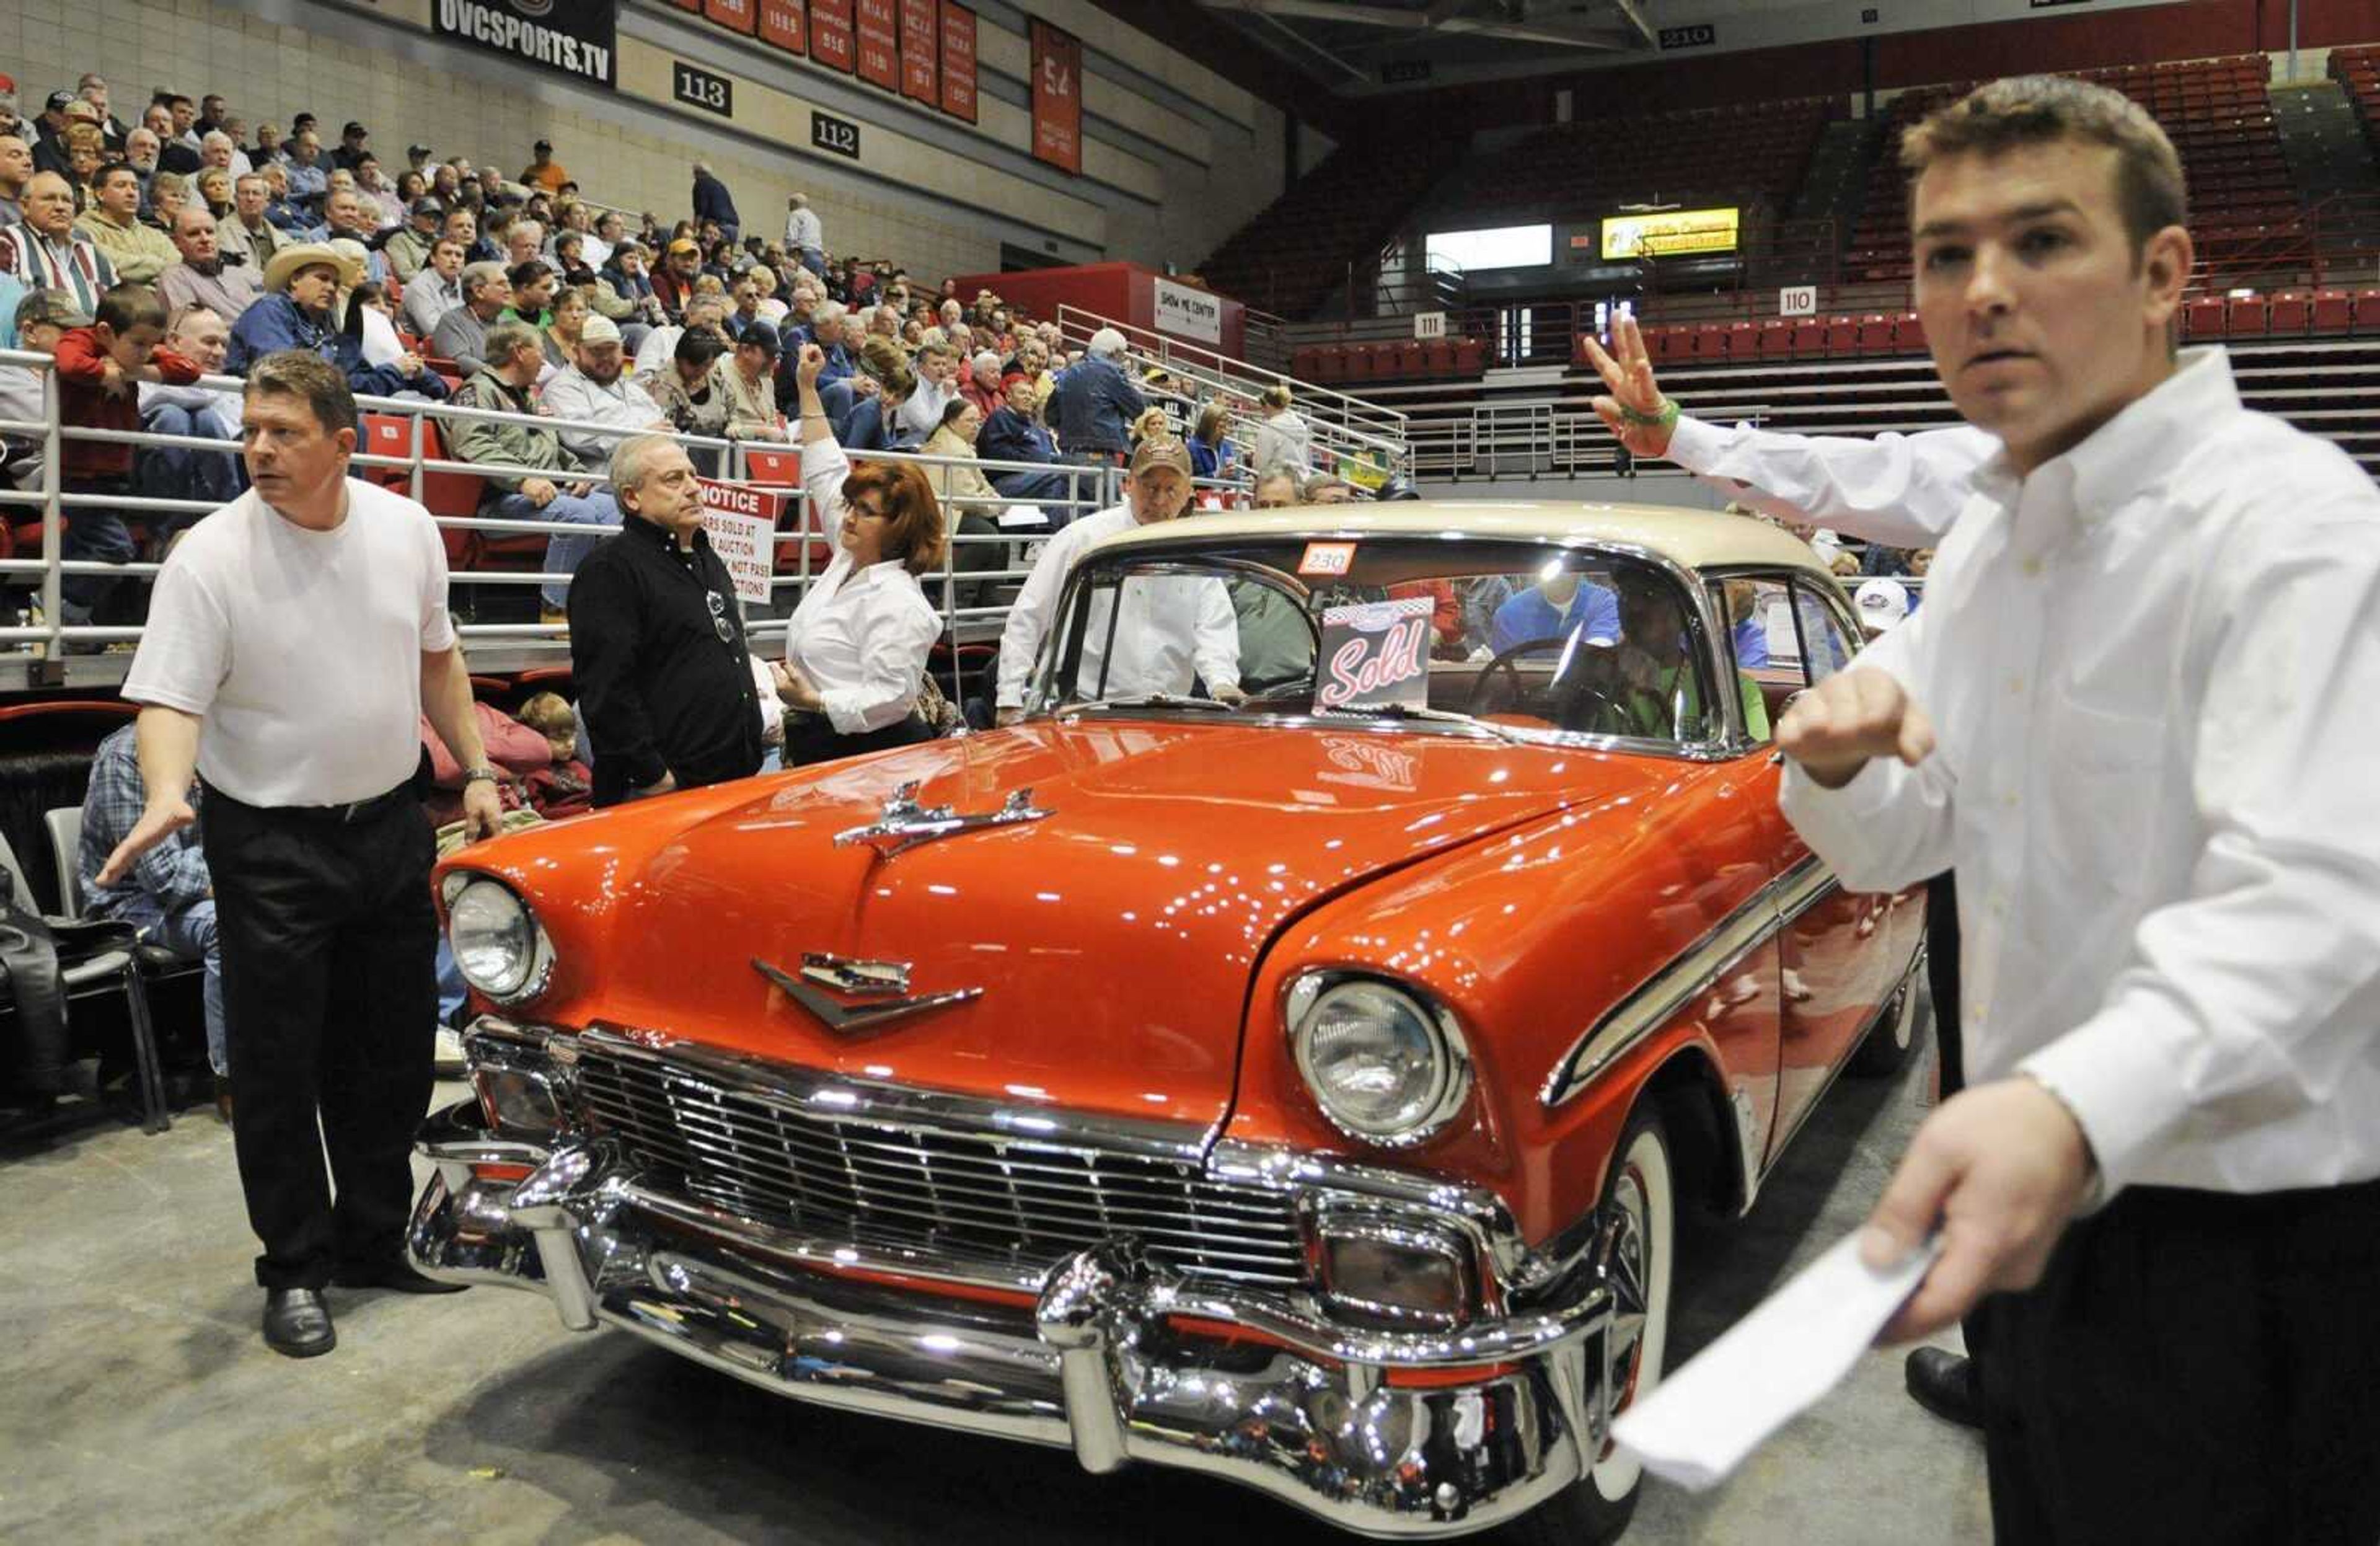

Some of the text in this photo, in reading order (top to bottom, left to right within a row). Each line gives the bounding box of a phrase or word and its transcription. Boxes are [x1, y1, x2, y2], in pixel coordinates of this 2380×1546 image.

[681, 72, 725, 108] 113
[818, 120, 855, 152] 112
[1786, 291, 1810, 311] 110
[1421, 317, 1438, 335] 111
[721, 518, 743, 536] SOLD
[745, 524, 756, 537] AT
[718, 537, 755, 557] AUCTION
[731, 560, 769, 578] NOT PASS
[1320, 618, 1424, 707] Sold
